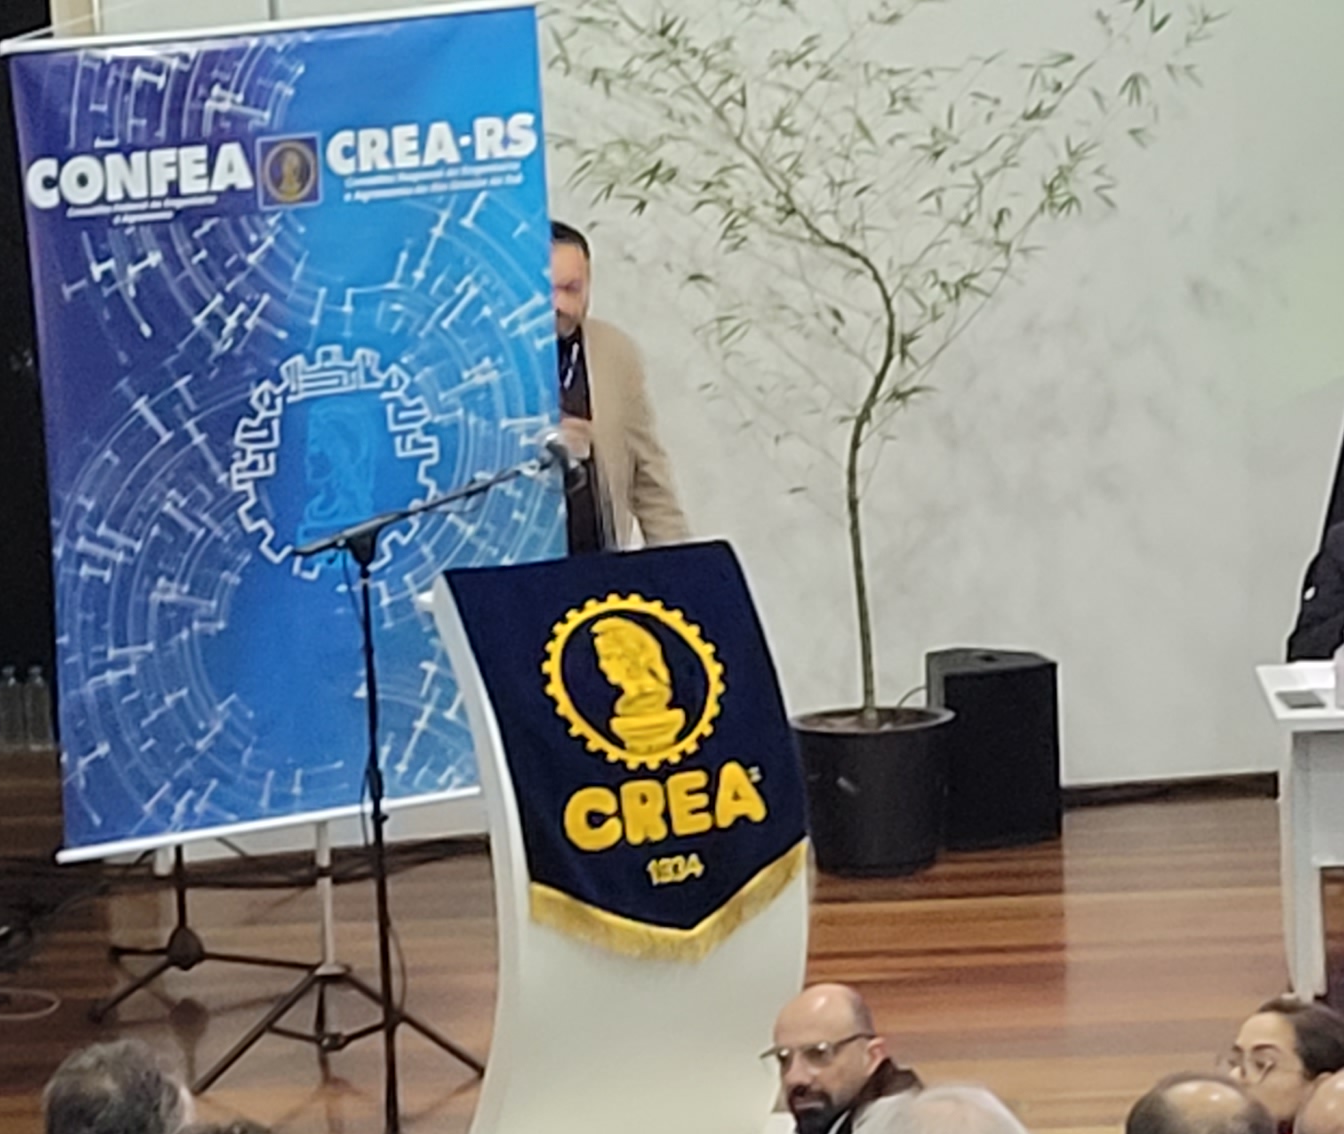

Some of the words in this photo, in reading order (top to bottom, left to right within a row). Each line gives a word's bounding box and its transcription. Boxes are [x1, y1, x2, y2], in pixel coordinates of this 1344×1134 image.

[26, 141, 254, 210] CONFEA
[326, 112, 538, 176] CREA-RS
[563, 760, 768, 853] CREA
